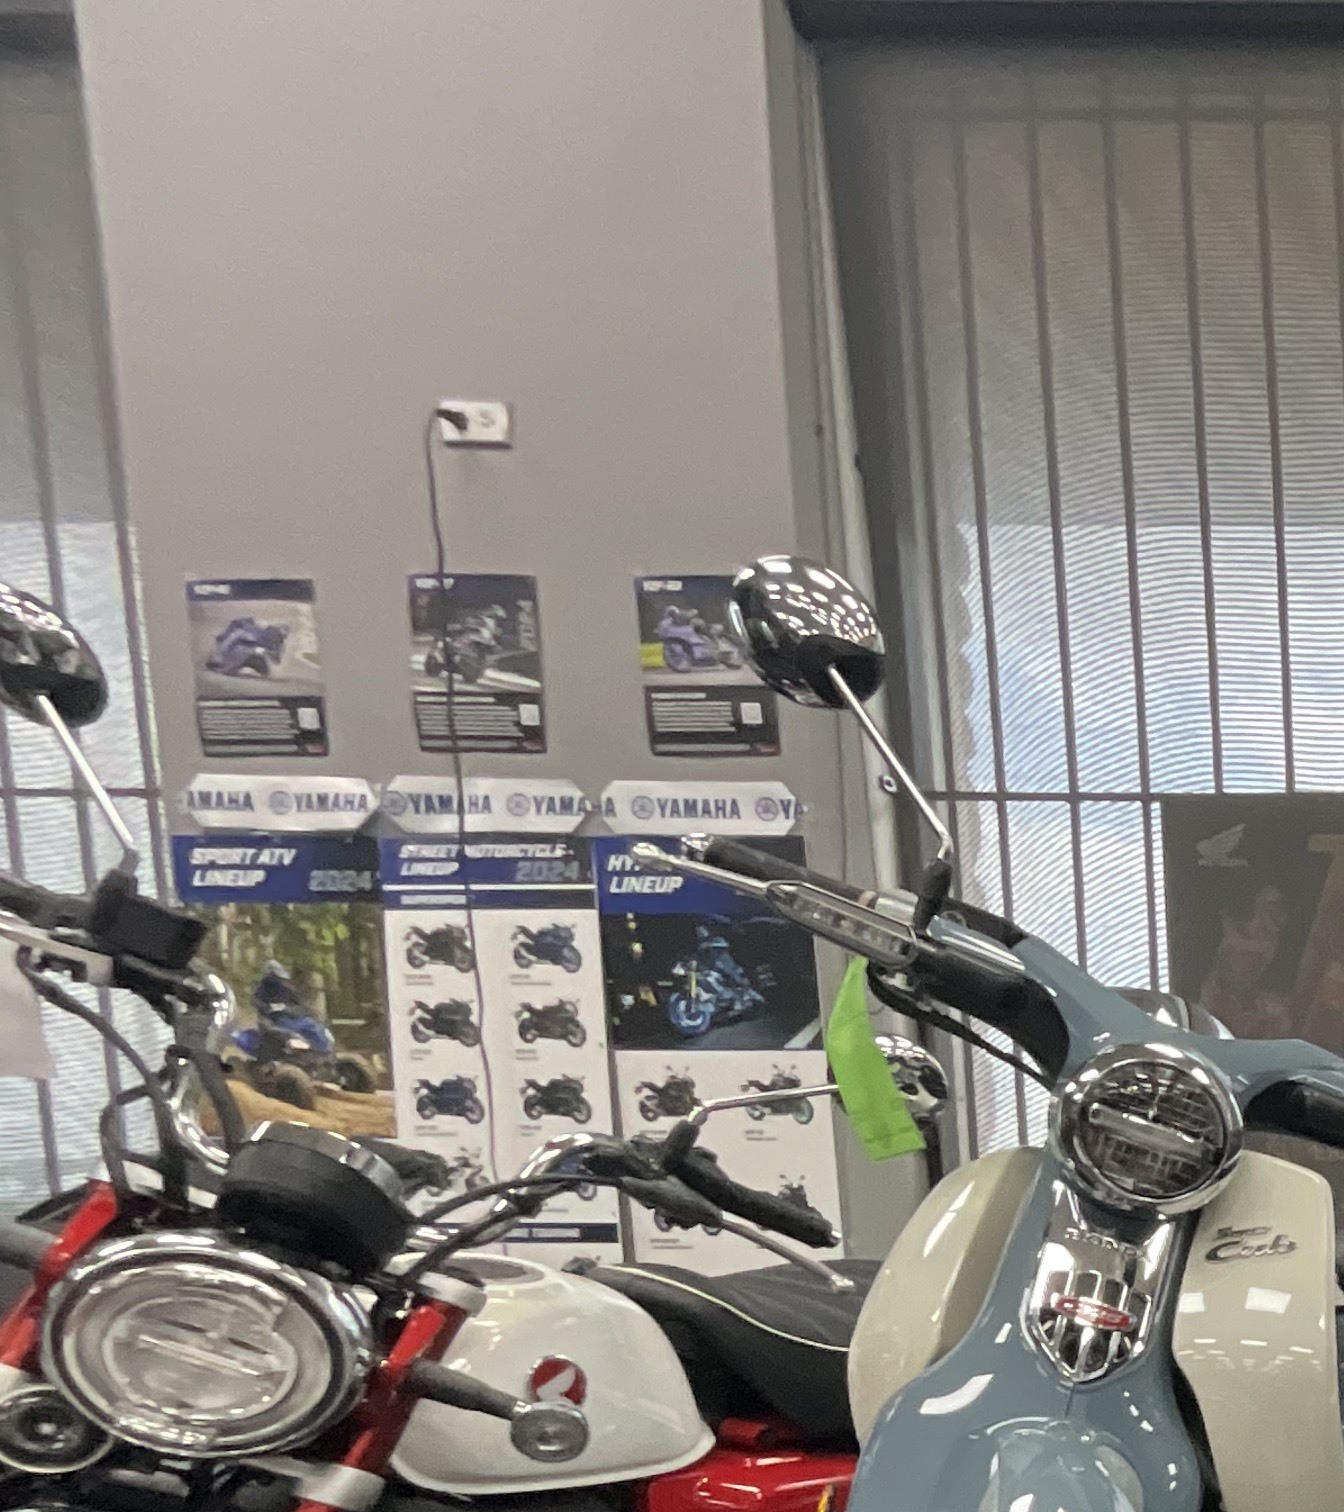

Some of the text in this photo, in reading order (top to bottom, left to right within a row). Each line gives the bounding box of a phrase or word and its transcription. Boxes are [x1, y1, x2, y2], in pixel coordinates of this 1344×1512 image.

[293, 792, 368, 812] YAMAHA
[656, 797, 741, 820] YAMAHA
[257, 847, 297, 866] ATV
[192, 869, 267, 887] LINEUP
[515, 860, 580, 882] 2024
[609, 875, 684, 894] LINEUP
